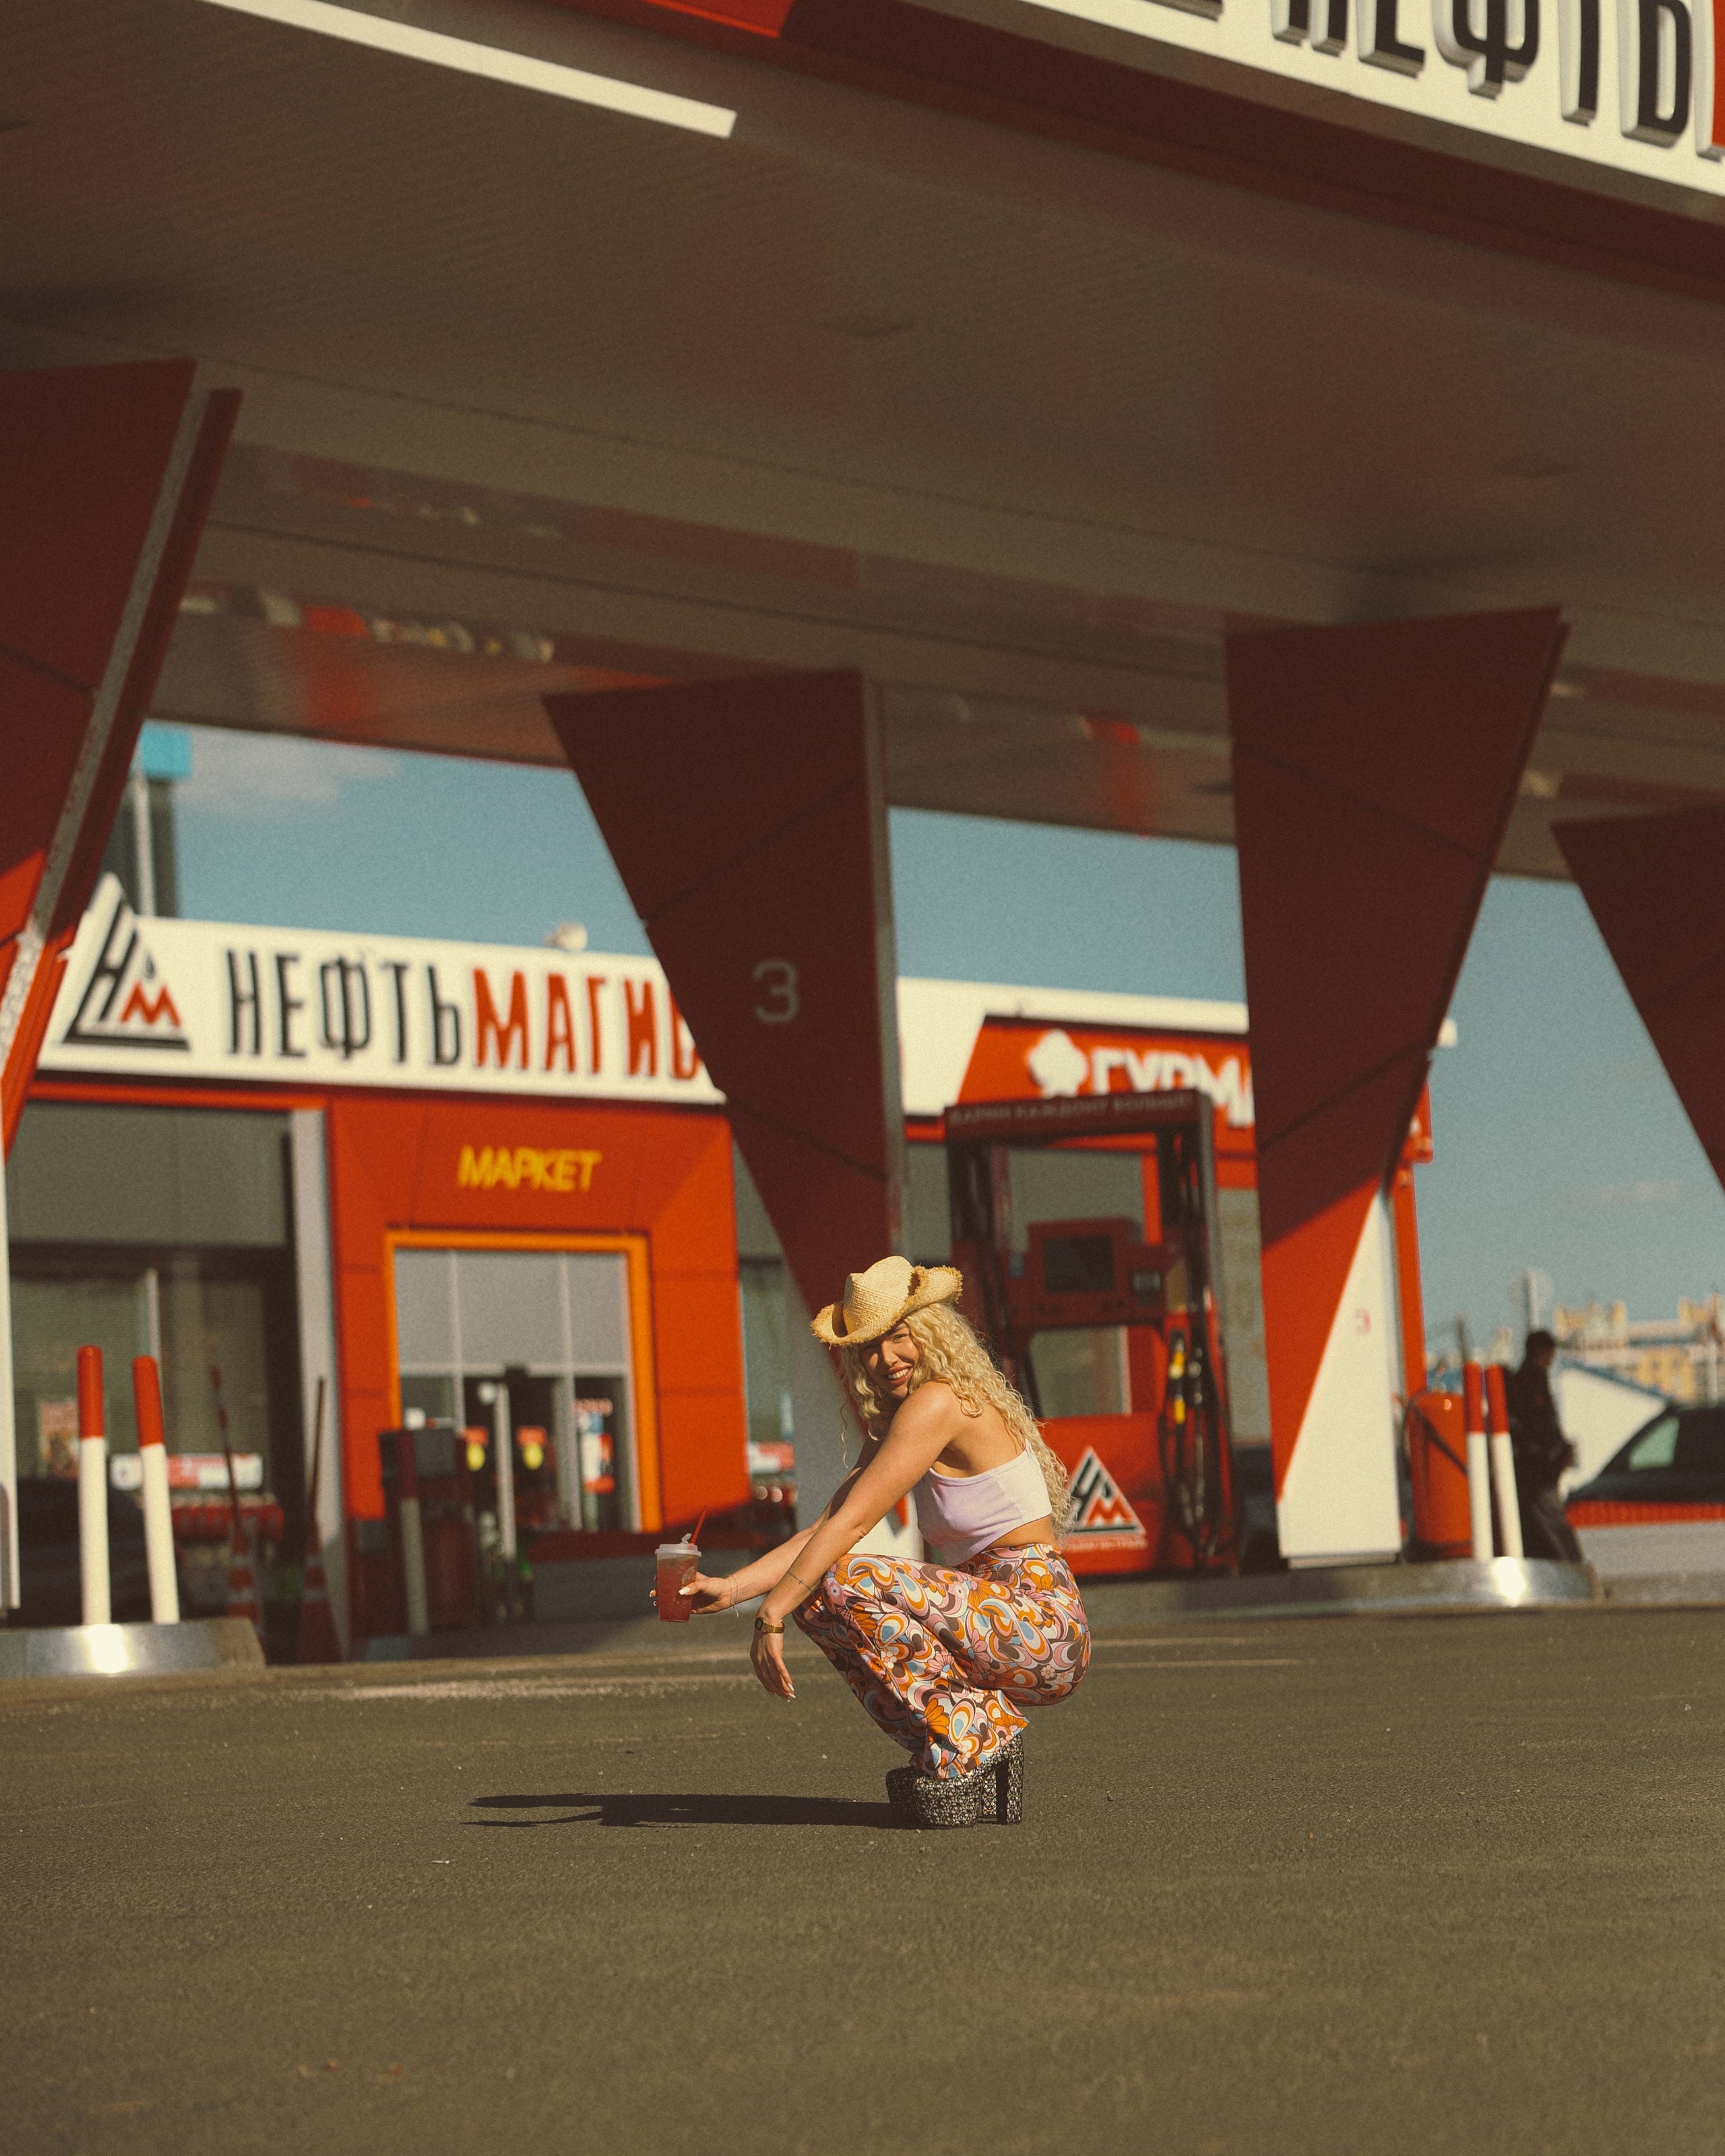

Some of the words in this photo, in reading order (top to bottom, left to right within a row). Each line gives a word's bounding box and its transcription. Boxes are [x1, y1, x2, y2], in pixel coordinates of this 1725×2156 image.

[753, 960, 798, 1023] 3
[1092, 1048, 1255, 1128] ГУРМ
[458, 1145, 602, 1192] МАРКЕТ
